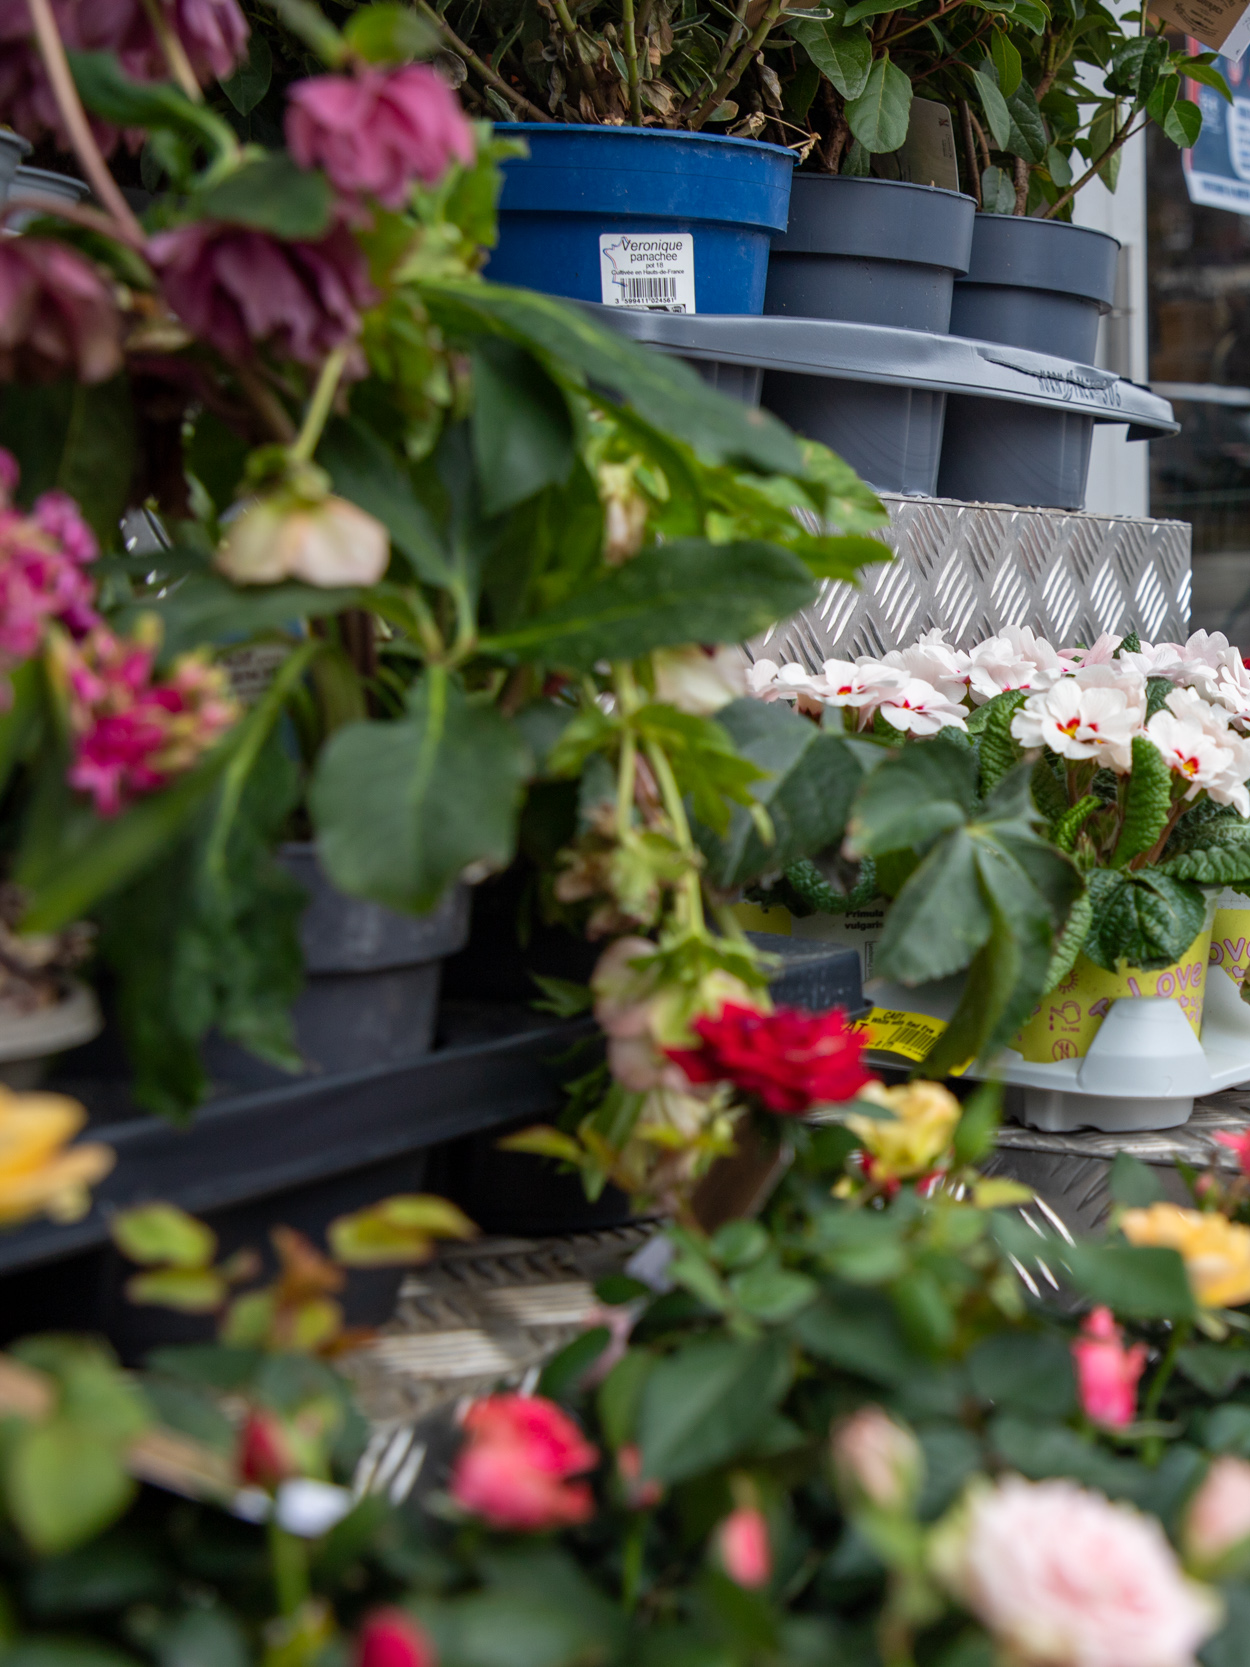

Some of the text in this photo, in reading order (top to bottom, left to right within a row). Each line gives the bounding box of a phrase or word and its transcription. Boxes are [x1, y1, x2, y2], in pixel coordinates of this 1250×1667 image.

[622, 239, 683, 253] Veronique
[630, 252, 678, 263] panachee
[846, 910, 884, 918] Primula
